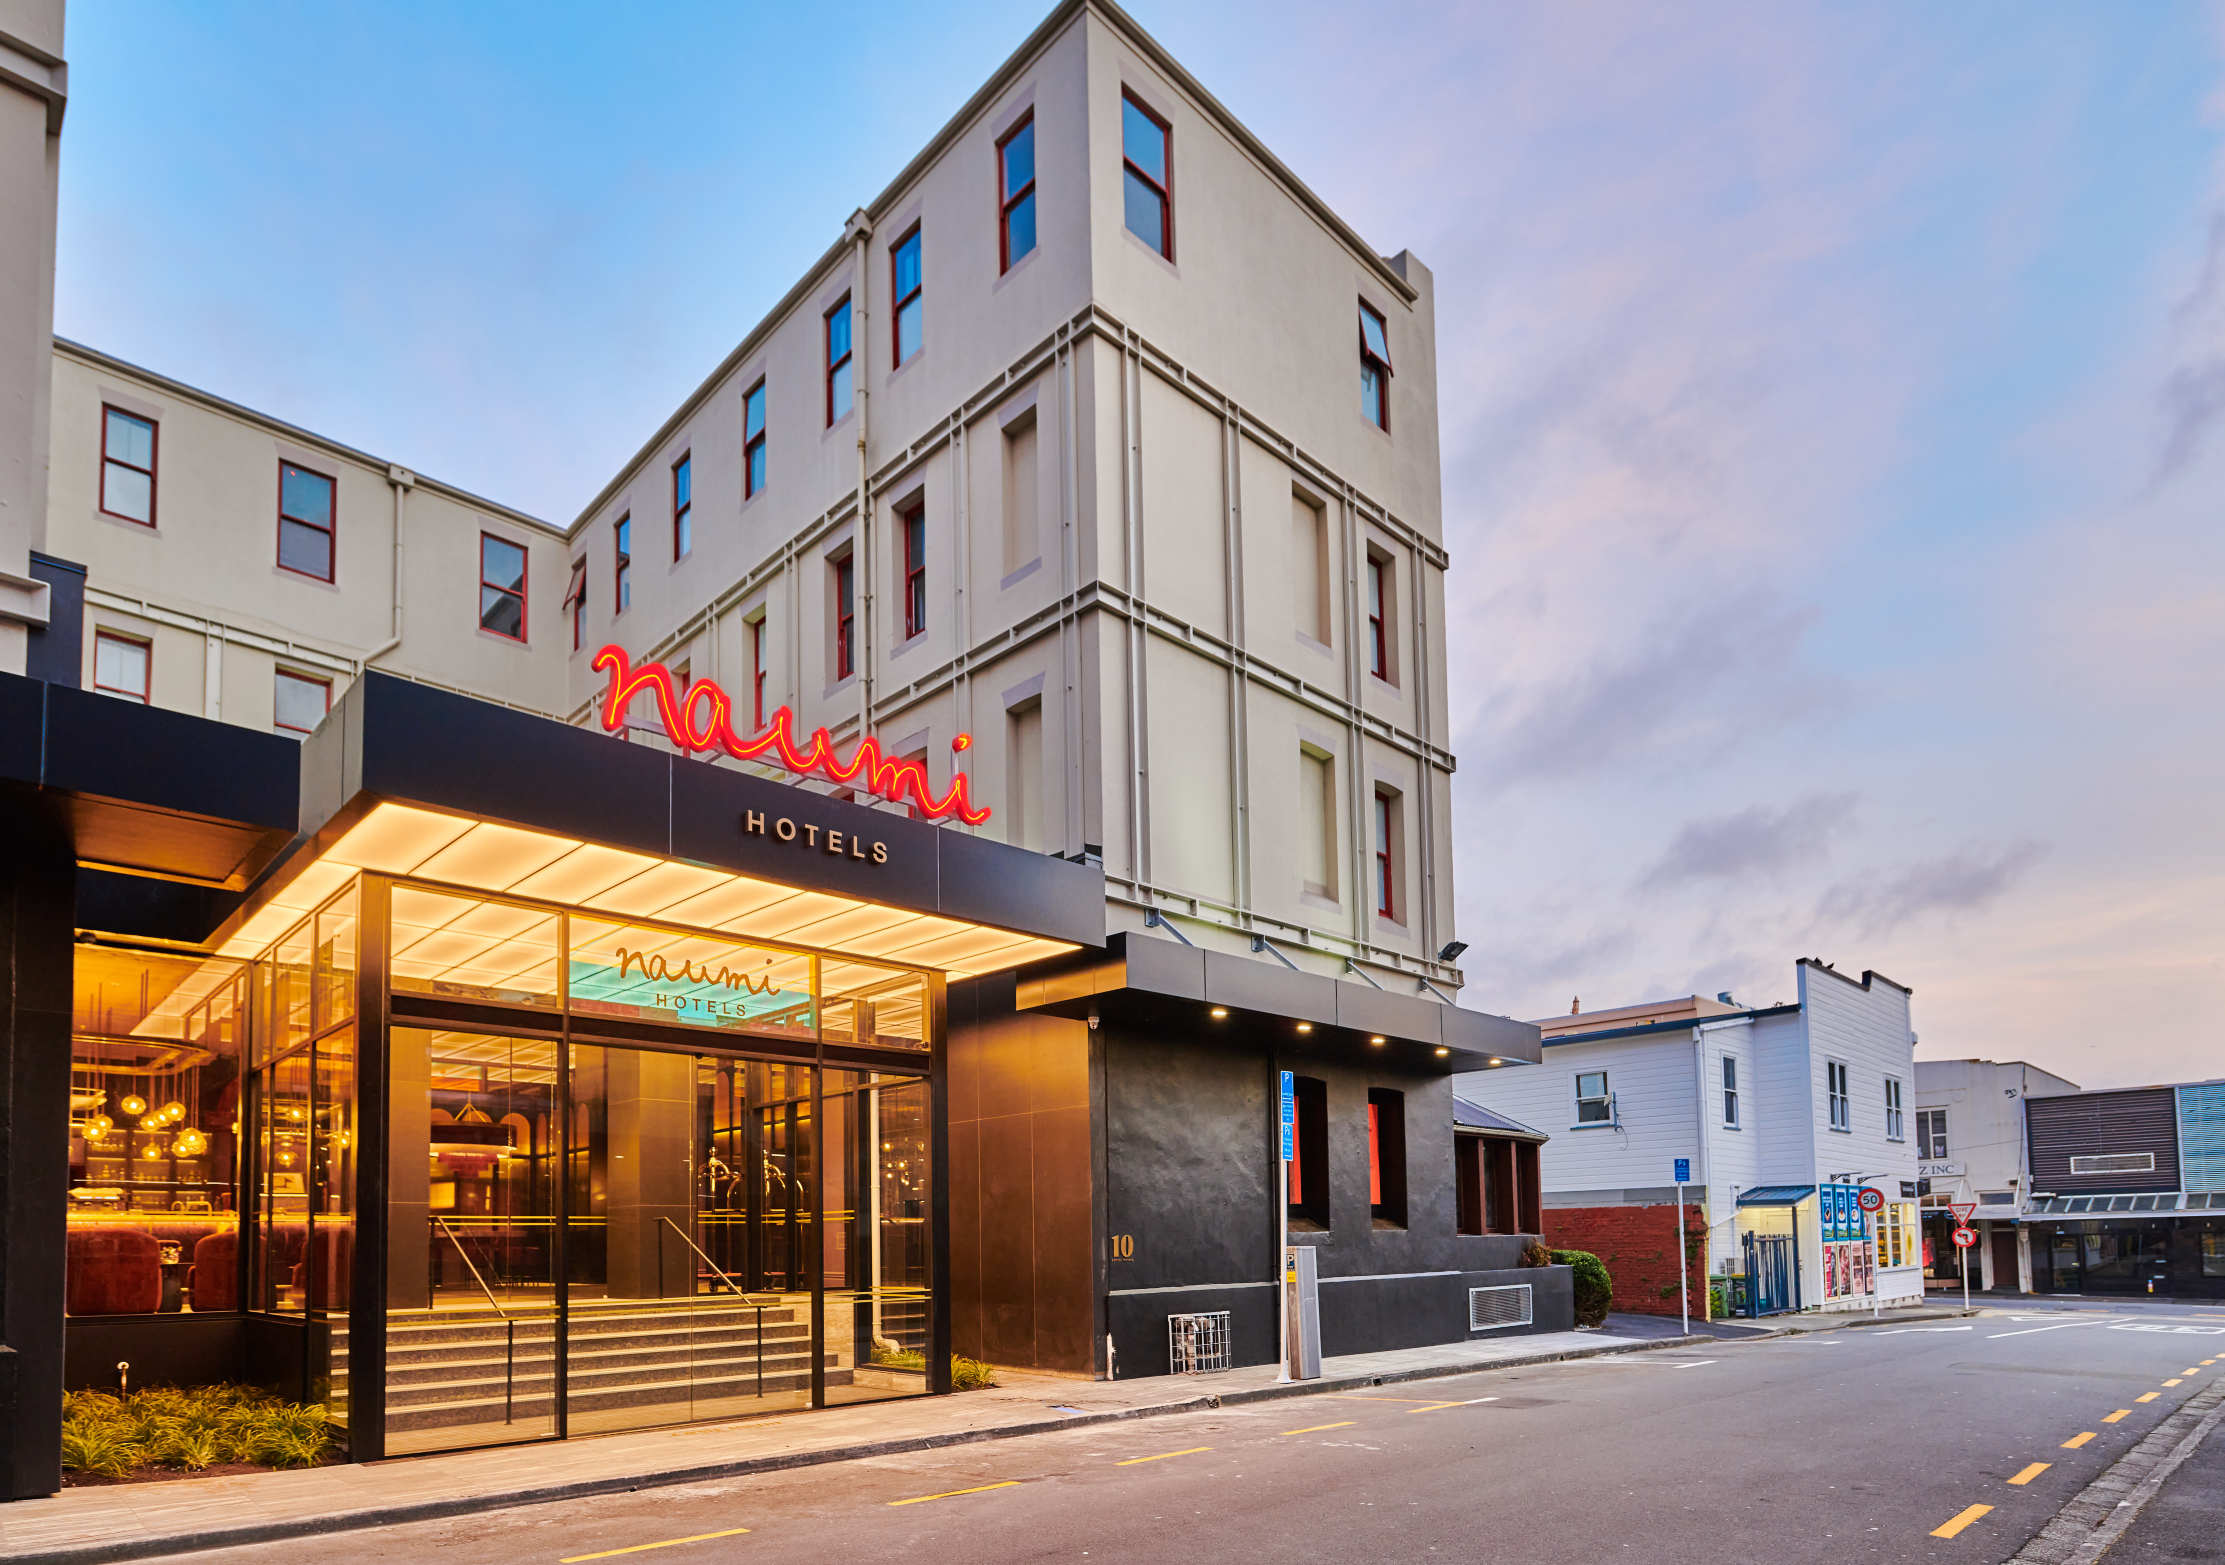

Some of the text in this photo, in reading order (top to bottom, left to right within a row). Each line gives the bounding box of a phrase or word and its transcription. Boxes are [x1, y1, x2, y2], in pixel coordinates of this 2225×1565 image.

[591, 644, 992, 826] naumi
[746, 809, 888, 864] HOTELS
[616, 947, 780, 996] naumi
[656, 994, 746, 1016] HOTELS
[1932, 1165, 1954, 1174] INC
[1863, 1195, 1878, 1205] 50
[1112, 1234, 1134, 1257] 10
[1287, 1255, 1294, 1266] P
